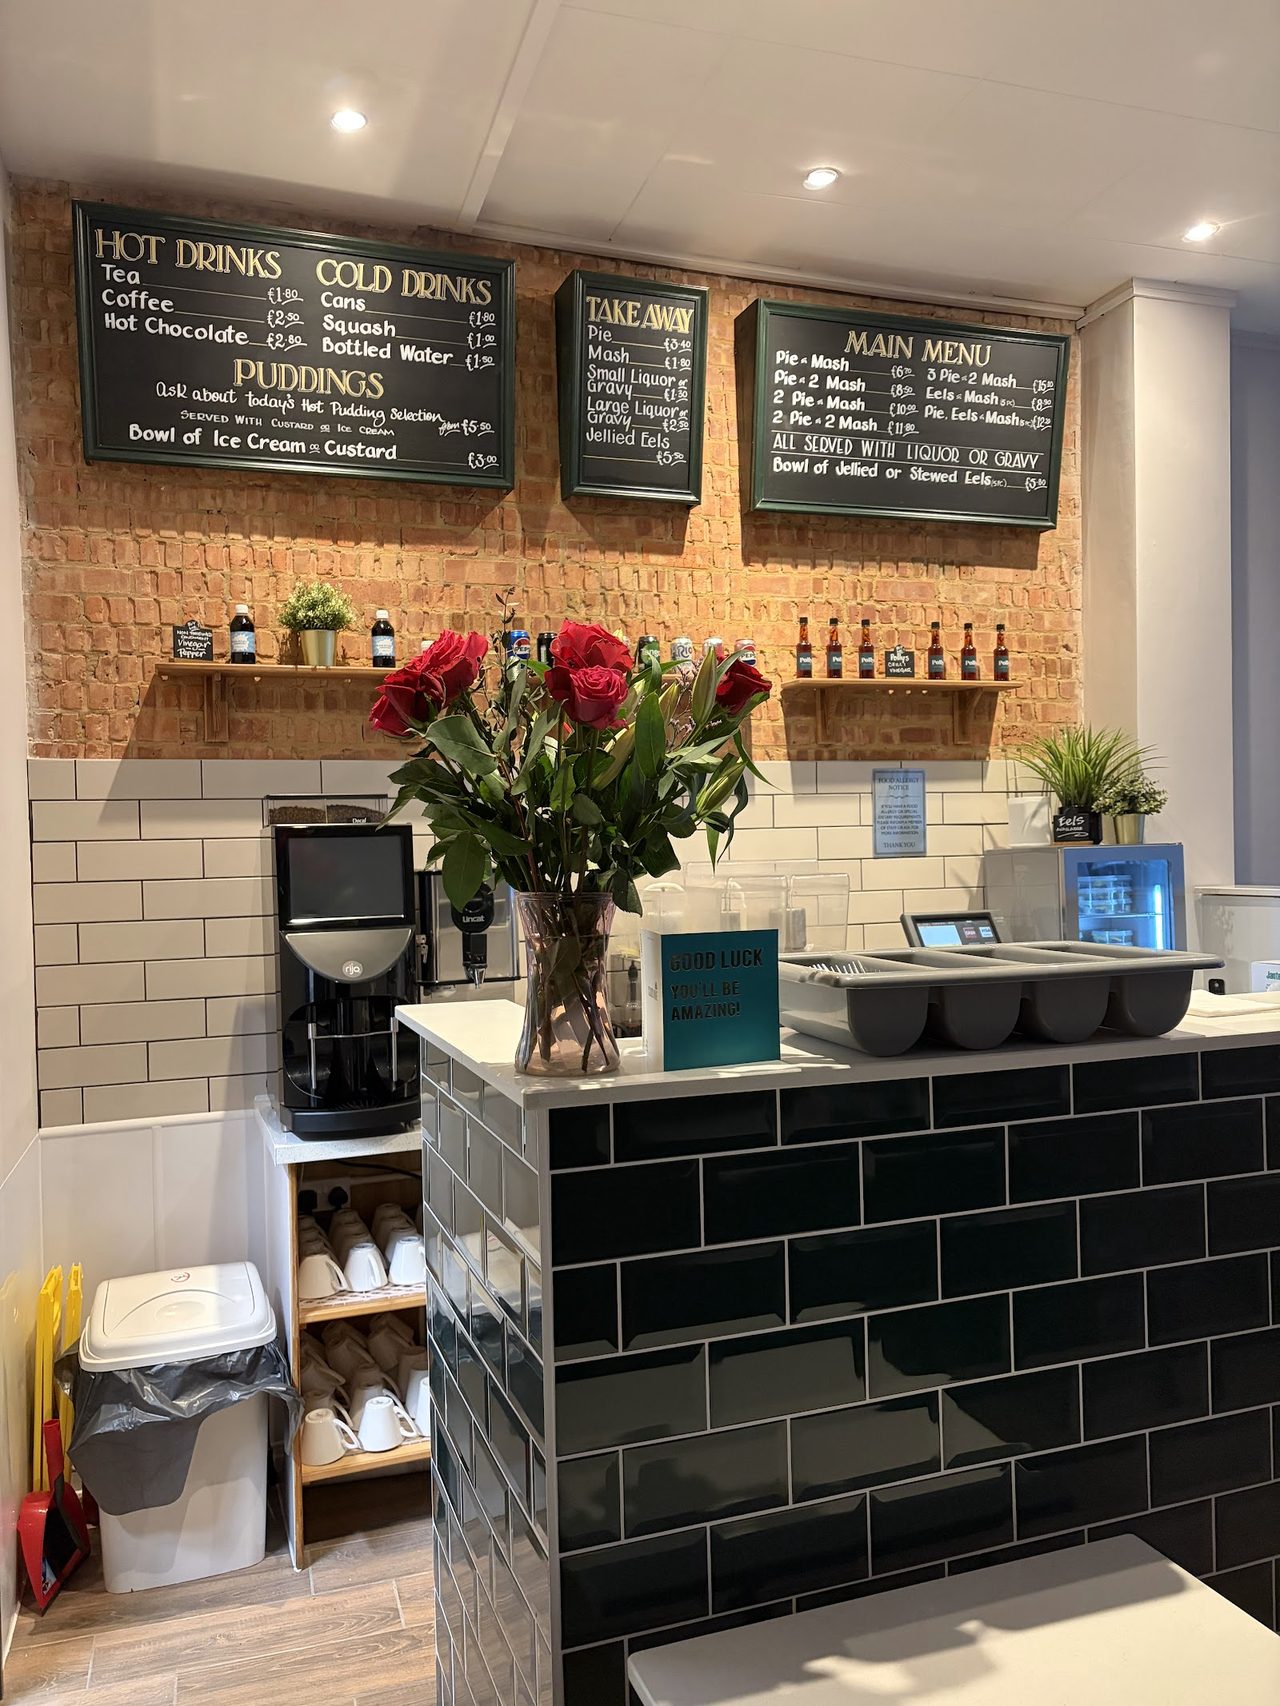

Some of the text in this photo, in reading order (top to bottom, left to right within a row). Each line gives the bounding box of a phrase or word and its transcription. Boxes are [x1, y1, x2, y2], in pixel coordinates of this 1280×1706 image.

[95, 228, 282, 279] HOT DRINKS
[101, 264, 140, 284] Tea
[316, 258, 492, 306] COLD DRINKS
[102, 290, 174, 313] Coffee
[321, 292, 366, 311] Cans
[322, 314, 396, 336] Squash
[586, 296, 694, 334] TAKE AWAY
[104, 313, 138, 331] Hot
[145, 317, 249, 344] Chocolate
[588, 324, 612, 342] Pie
[322, 337, 391, 358] Bottled
[400, 345, 453, 364] Water
[588, 345, 629, 364] Mash
[844, 330, 991, 367] MAIN MENU
[776, 350, 798, 365] Pie
[811, 354, 849, 372] Mash
[234, 359, 384, 399] PUDDINGS
[587, 364, 688, 389] Small Liquor or
[774, 369, 798, 386] Pie
[808, 374, 819, 388] 2
[826, 376, 866, 392] Mash
[927, 368, 936, 380] 3
[939, 369, 960, 382] Pie
[968, 372, 978, 384] 2
[982, 372, 1016, 388] Mash
[587, 380, 632, 400] Gravy
[773, 390, 784, 404] 2
[792, 390, 814, 407] Pie
[826, 395, 865, 411] Mash
[926, 386, 954, 400] Eels
[964, 390, 998, 405] Mash
[156, 382, 188, 399] Ask
[192, 387, 237, 403] about
[245, 392, 295, 414] today's
[301, 399, 324, 413] Hot
[330, 402, 385, 427] Pudding
[390, 408, 444, 422] Selection
[587, 396, 688, 419] Large Liquor or
[180, 410, 229, 423] SERVED
[236, 415, 262, 426] WITH
[272, 418, 314, 430] CUSTARD
[359, 426, 395, 436] CREAM
[588, 411, 632, 432] Gravy
[772, 410, 783, 424] 2
[790, 410, 812, 426] Pie
[825, 415, 835, 428] 2
[839, 416, 877, 432] Mash
[952, 408, 978, 422] Eels
[985, 410, 1019, 426] Mash
[129, 424, 176, 442] Bowl
[183, 428, 202, 445] of
[214, 430, 241, 449] Ice
[247, 433, 306, 454] Cream
[324, 440, 396, 460] Custard
[586, 427, 670, 449] Jellied Eels
[773, 433, 1038, 469] ALL SERVED WITH LIQUOR OR GRAVY
[773, 457, 808, 473] Bowl
[814, 459, 828, 474] of
[835, 460, 878, 477] Jellied
[886, 466, 901, 479] or
[910, 466, 957, 482] Stewed
[965, 472, 991, 486] Eels
[177, 648, 206, 658] Pepper
[178, 639, 211, 650] Vinegar
[1058, 816, 1084, 826] Eels
[670, 948, 763, 972] GOOD LUCK
[672, 981, 718, 999] YOU'LL
[722, 981, 740, 996] BE
[672, 1002, 740, 1021] AMAZING!
